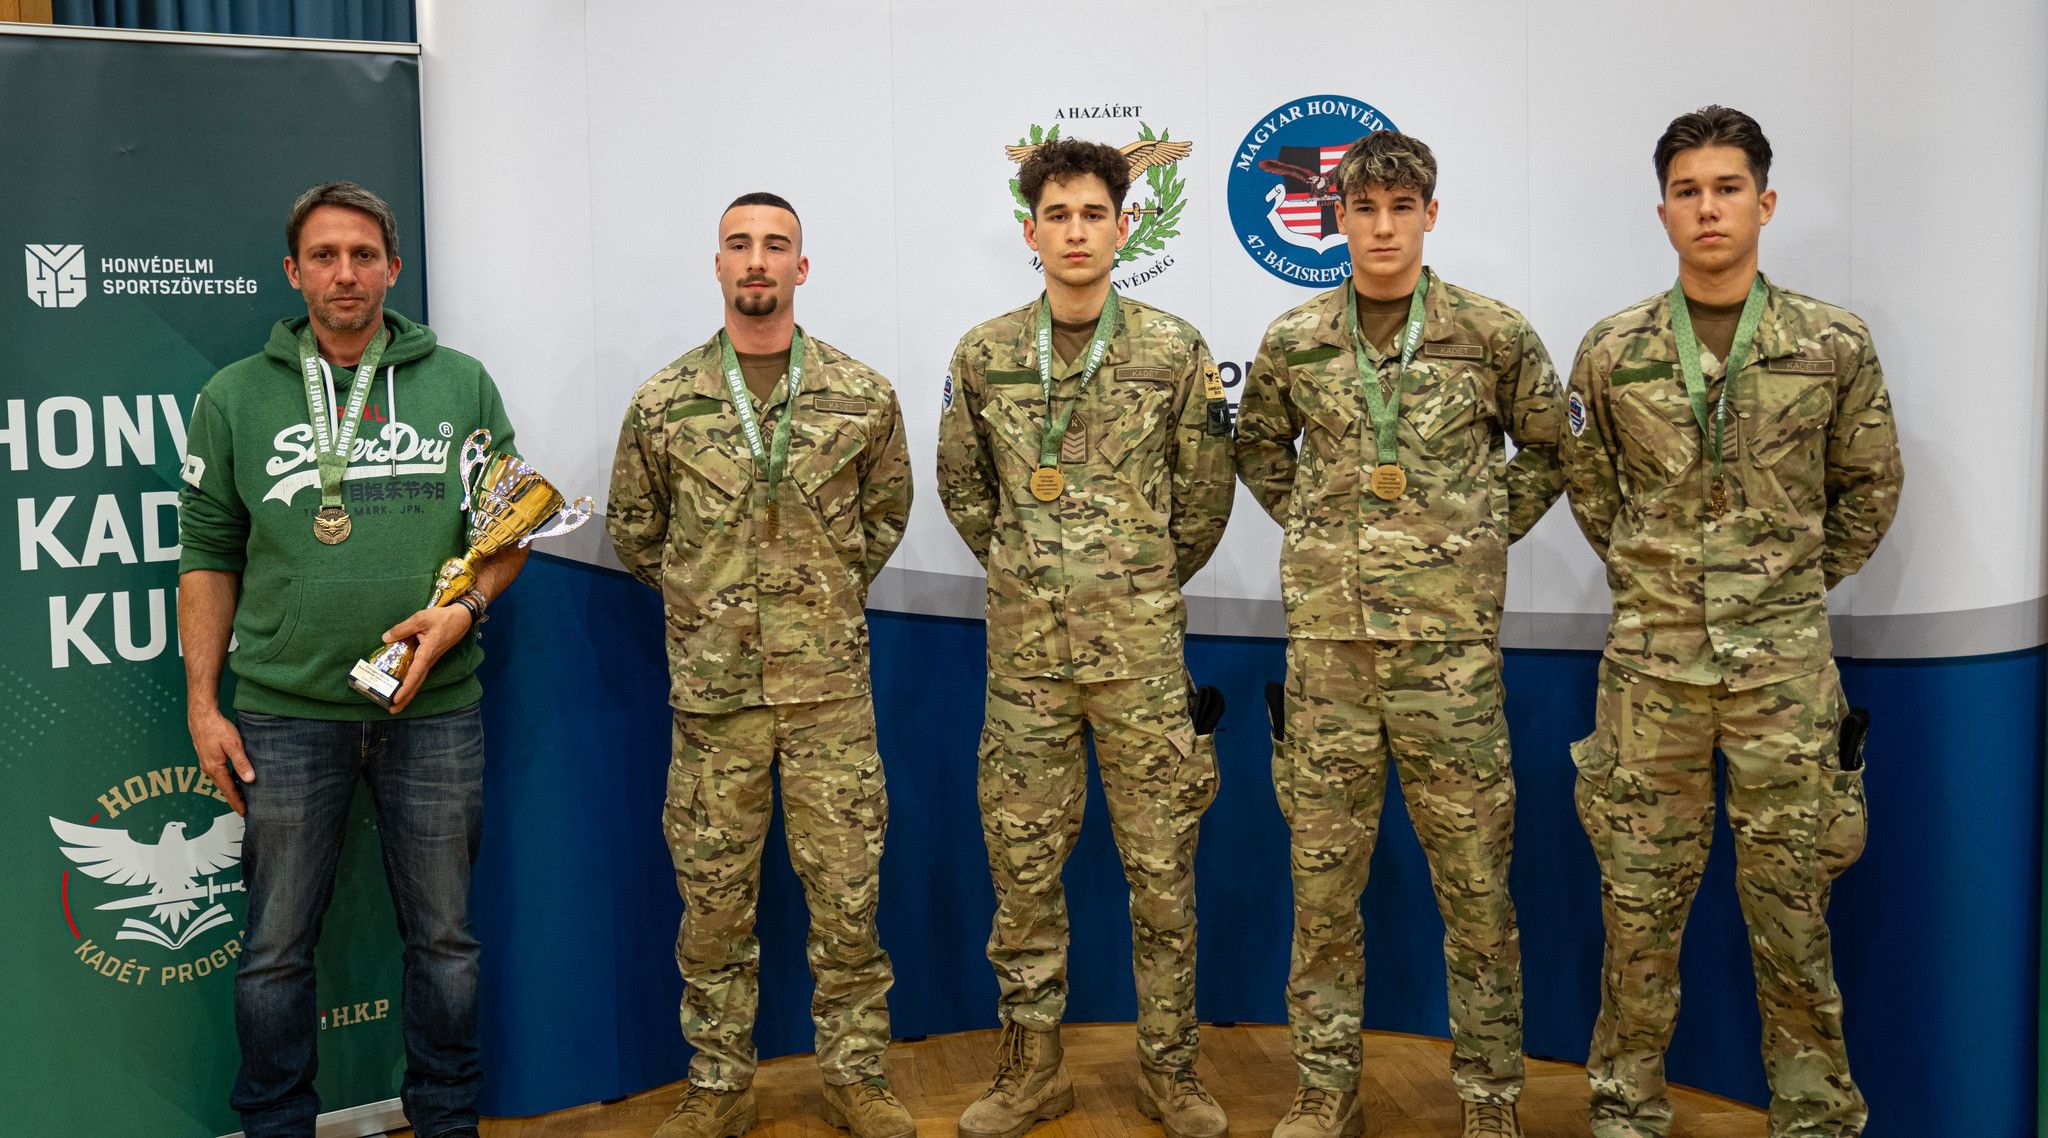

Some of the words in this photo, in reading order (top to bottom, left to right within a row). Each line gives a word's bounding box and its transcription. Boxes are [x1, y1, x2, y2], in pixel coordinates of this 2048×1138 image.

[1055, 108, 1065, 119] A
[1069, 103, 1142, 119] HAZÁÉRT
[1237, 105, 1304, 172] MAGYAR
[1306, 100, 1390, 133] HONVÉD
[101, 256, 213, 274] HONVÉDELMI
[1112, 254, 1175, 291] NVÉDSÉG
[1246, 234, 1265, 256] 47.
[1263, 249, 1354, 282] BÁZISREPÜ
[103, 276, 258, 295] SPORTSZÖVETSÉG
[1039, 328, 1048, 352] KUPA
[1408, 321, 1421, 345] KUPA
[1091, 339, 1106, 362] KUPA
[306, 356, 318, 382] KUPA
[728, 368, 742, 392] KUPA
[310, 384, 324, 413] KADÉT
[336, 421, 355, 457] HONVÉD
[347, 390, 364, 418] KADÉT
[356, 365, 372, 389] KUPA
[0, 394, 200, 471] HONV
[17, 491, 183, 571] KAD
[49, 588, 187, 668] KU
[74, 938, 151, 985] KADÉT
[161, 930, 245, 986] PROGR
